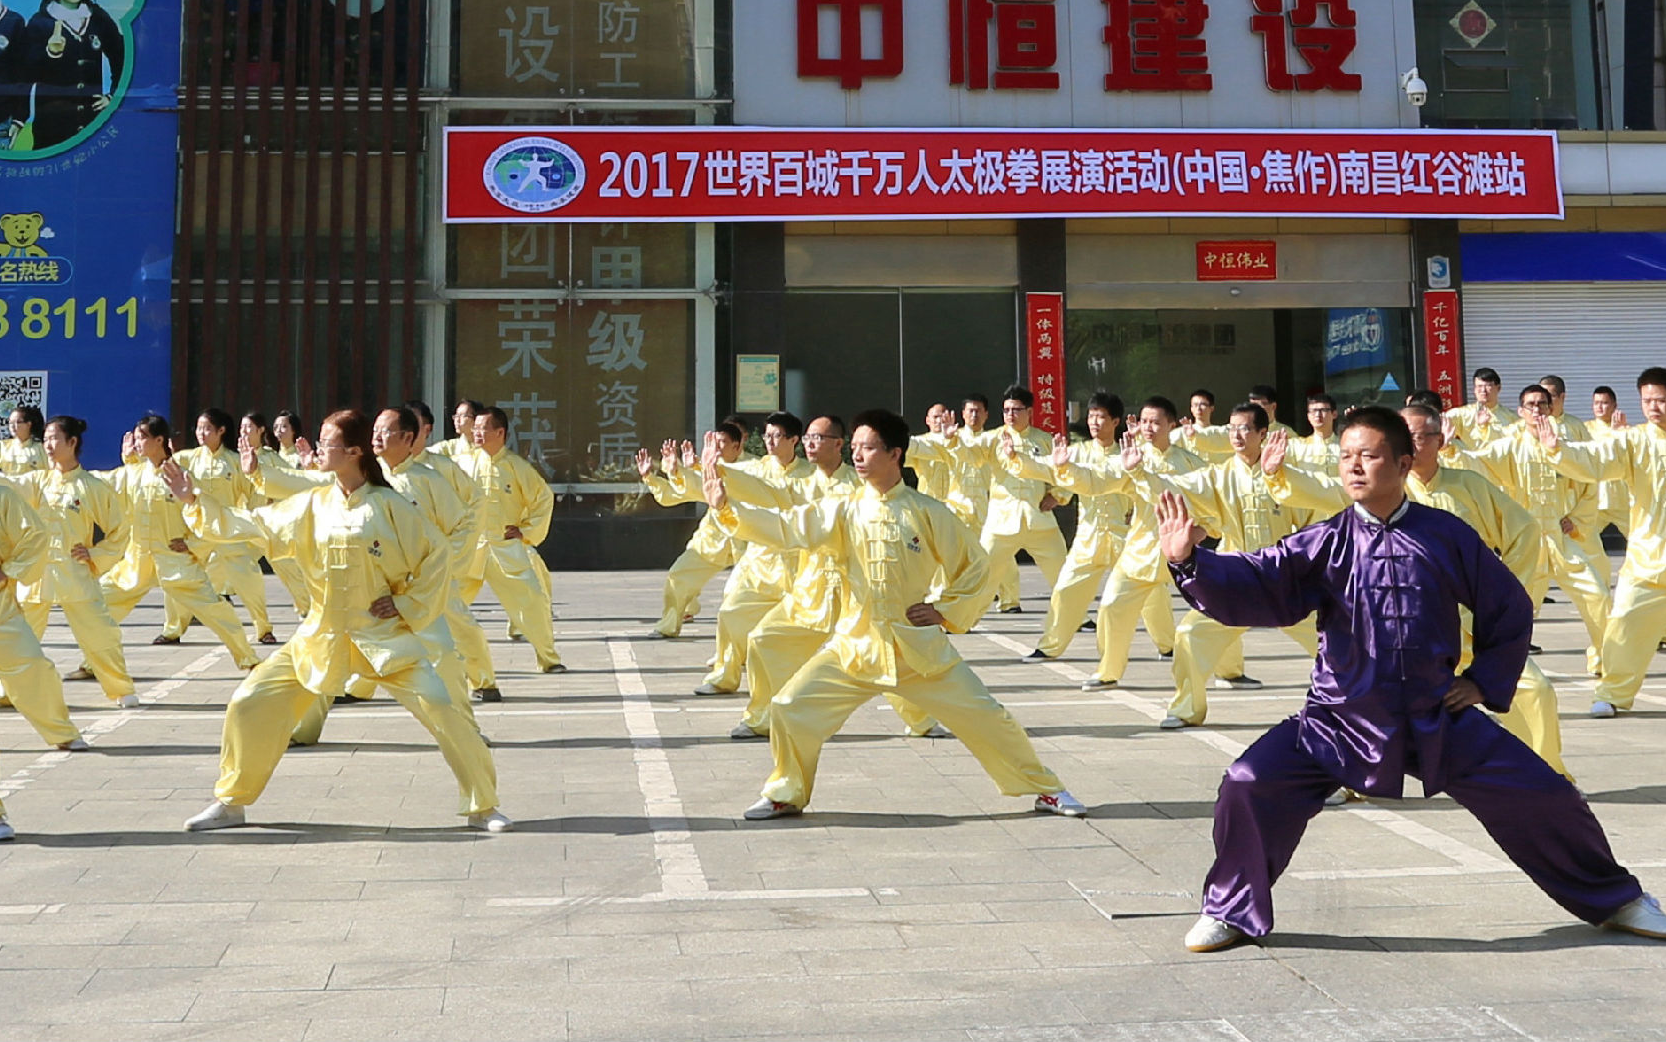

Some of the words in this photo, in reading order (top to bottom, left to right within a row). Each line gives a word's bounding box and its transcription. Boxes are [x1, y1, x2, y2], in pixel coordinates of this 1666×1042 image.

[1203, 252, 1269, 270] 中恒伟业
[21, 296, 138, 340] 8111
